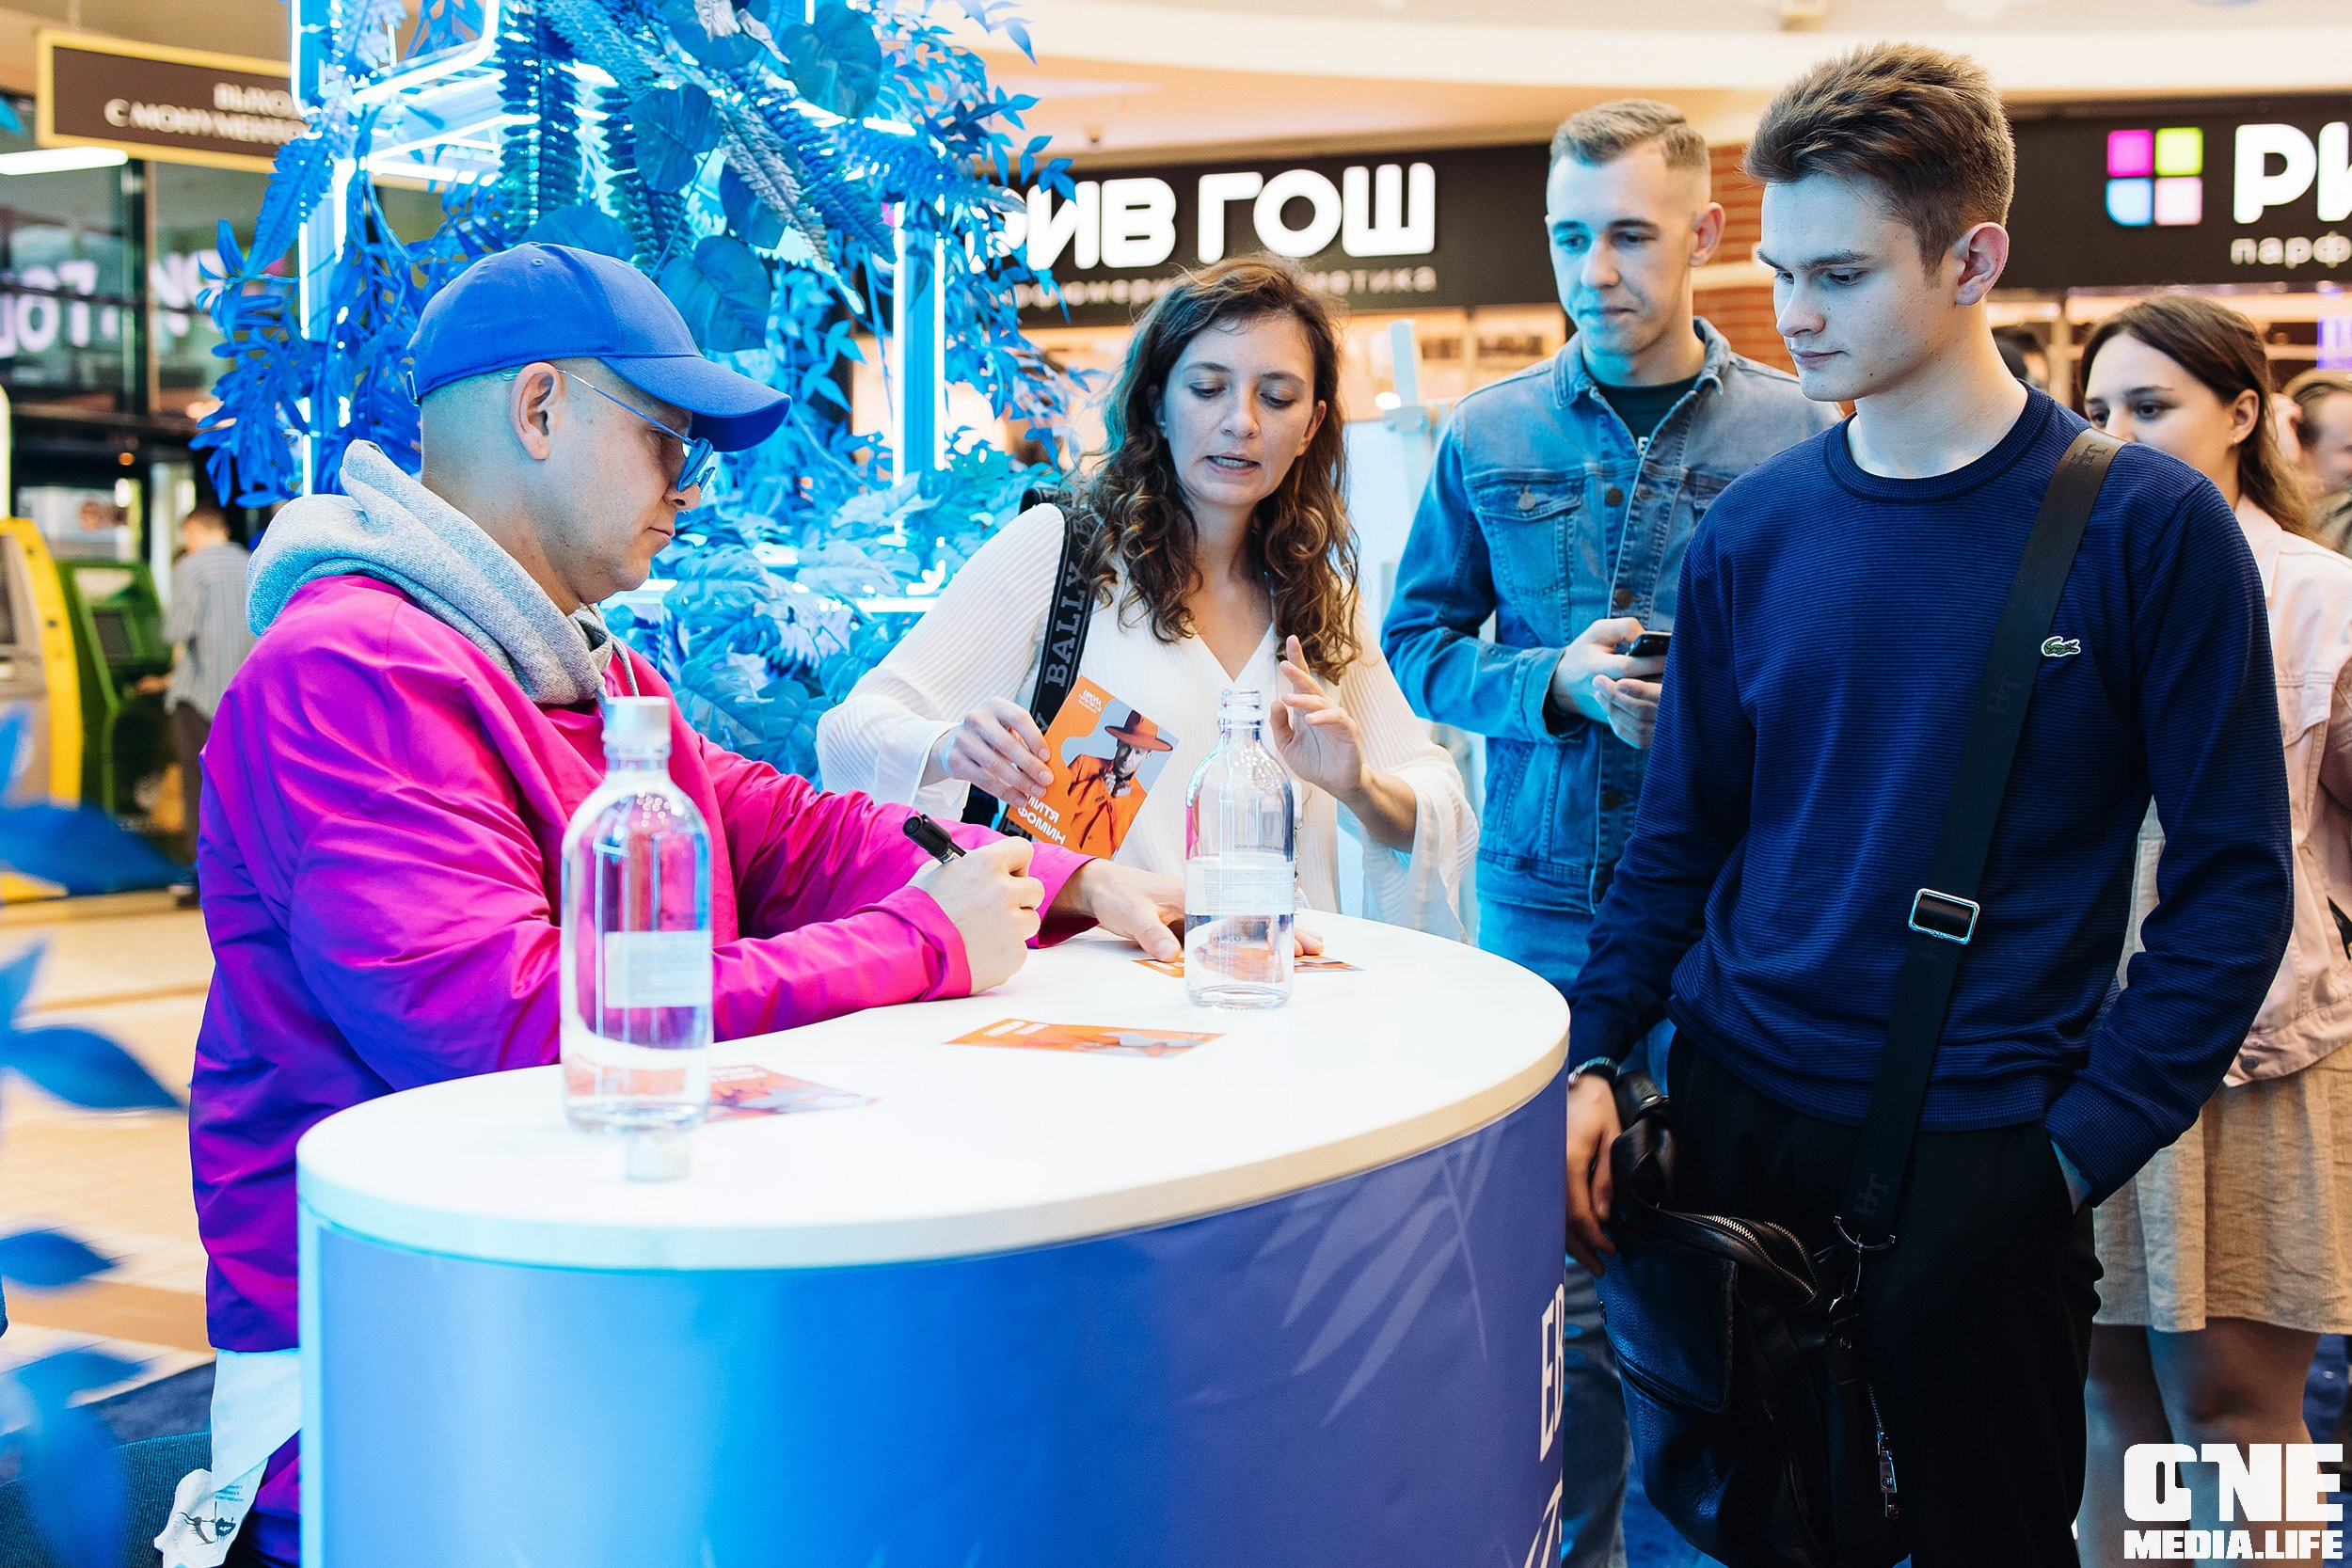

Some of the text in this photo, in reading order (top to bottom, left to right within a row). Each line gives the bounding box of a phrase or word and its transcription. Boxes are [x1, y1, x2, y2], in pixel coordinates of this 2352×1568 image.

[1198, 162, 1436, 264] ГОШ
[1044, 562, 1089, 688] BALLY
[1017, 806, 1067, 846] ФОМИН
